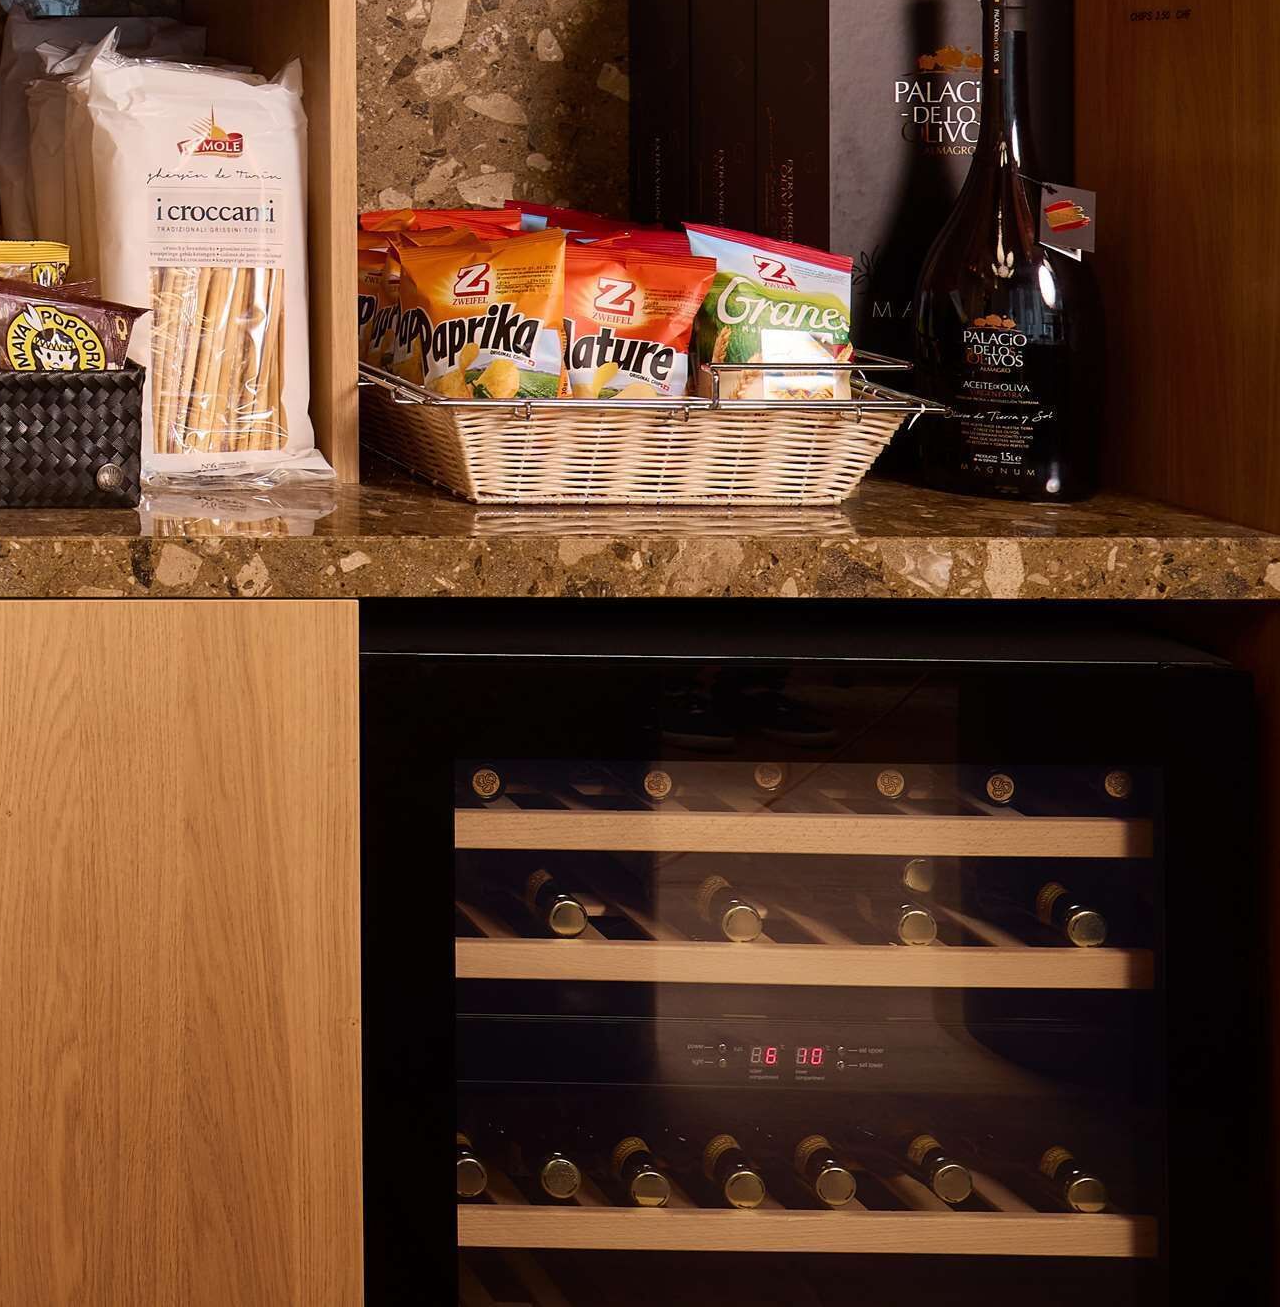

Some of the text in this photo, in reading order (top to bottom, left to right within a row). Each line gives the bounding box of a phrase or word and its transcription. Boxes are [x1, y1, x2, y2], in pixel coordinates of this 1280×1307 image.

[1176, 9, 1191, 19] CHF
[202, 141, 241, 152] MOLE
[214, 168, 231, 179] de
[156, 198, 163, 221] i
[453, 262, 491, 297] Z
[452, 296, 488, 306] ZWEIFEL
[595, 276, 637, 316] Z
[592, 311, 634, 325] ZWEIFEL
[18, 323, 33, 368] MAYA
[417, 302, 540, 377] Paprika
[963, 330, 1027, 347] PALACiO
[489, 350, 512, 359] ORIGINAL
[973, 344, 1016, 357] DE LOS
[629, 371, 650, 384] ORIGINAL
[987, 411, 1019, 422] Tierra
[1032, 410, 1054, 423] Sol
[960, 463, 1036, 477] MAGNUM
[765, 1047, 777, 1064] 6
